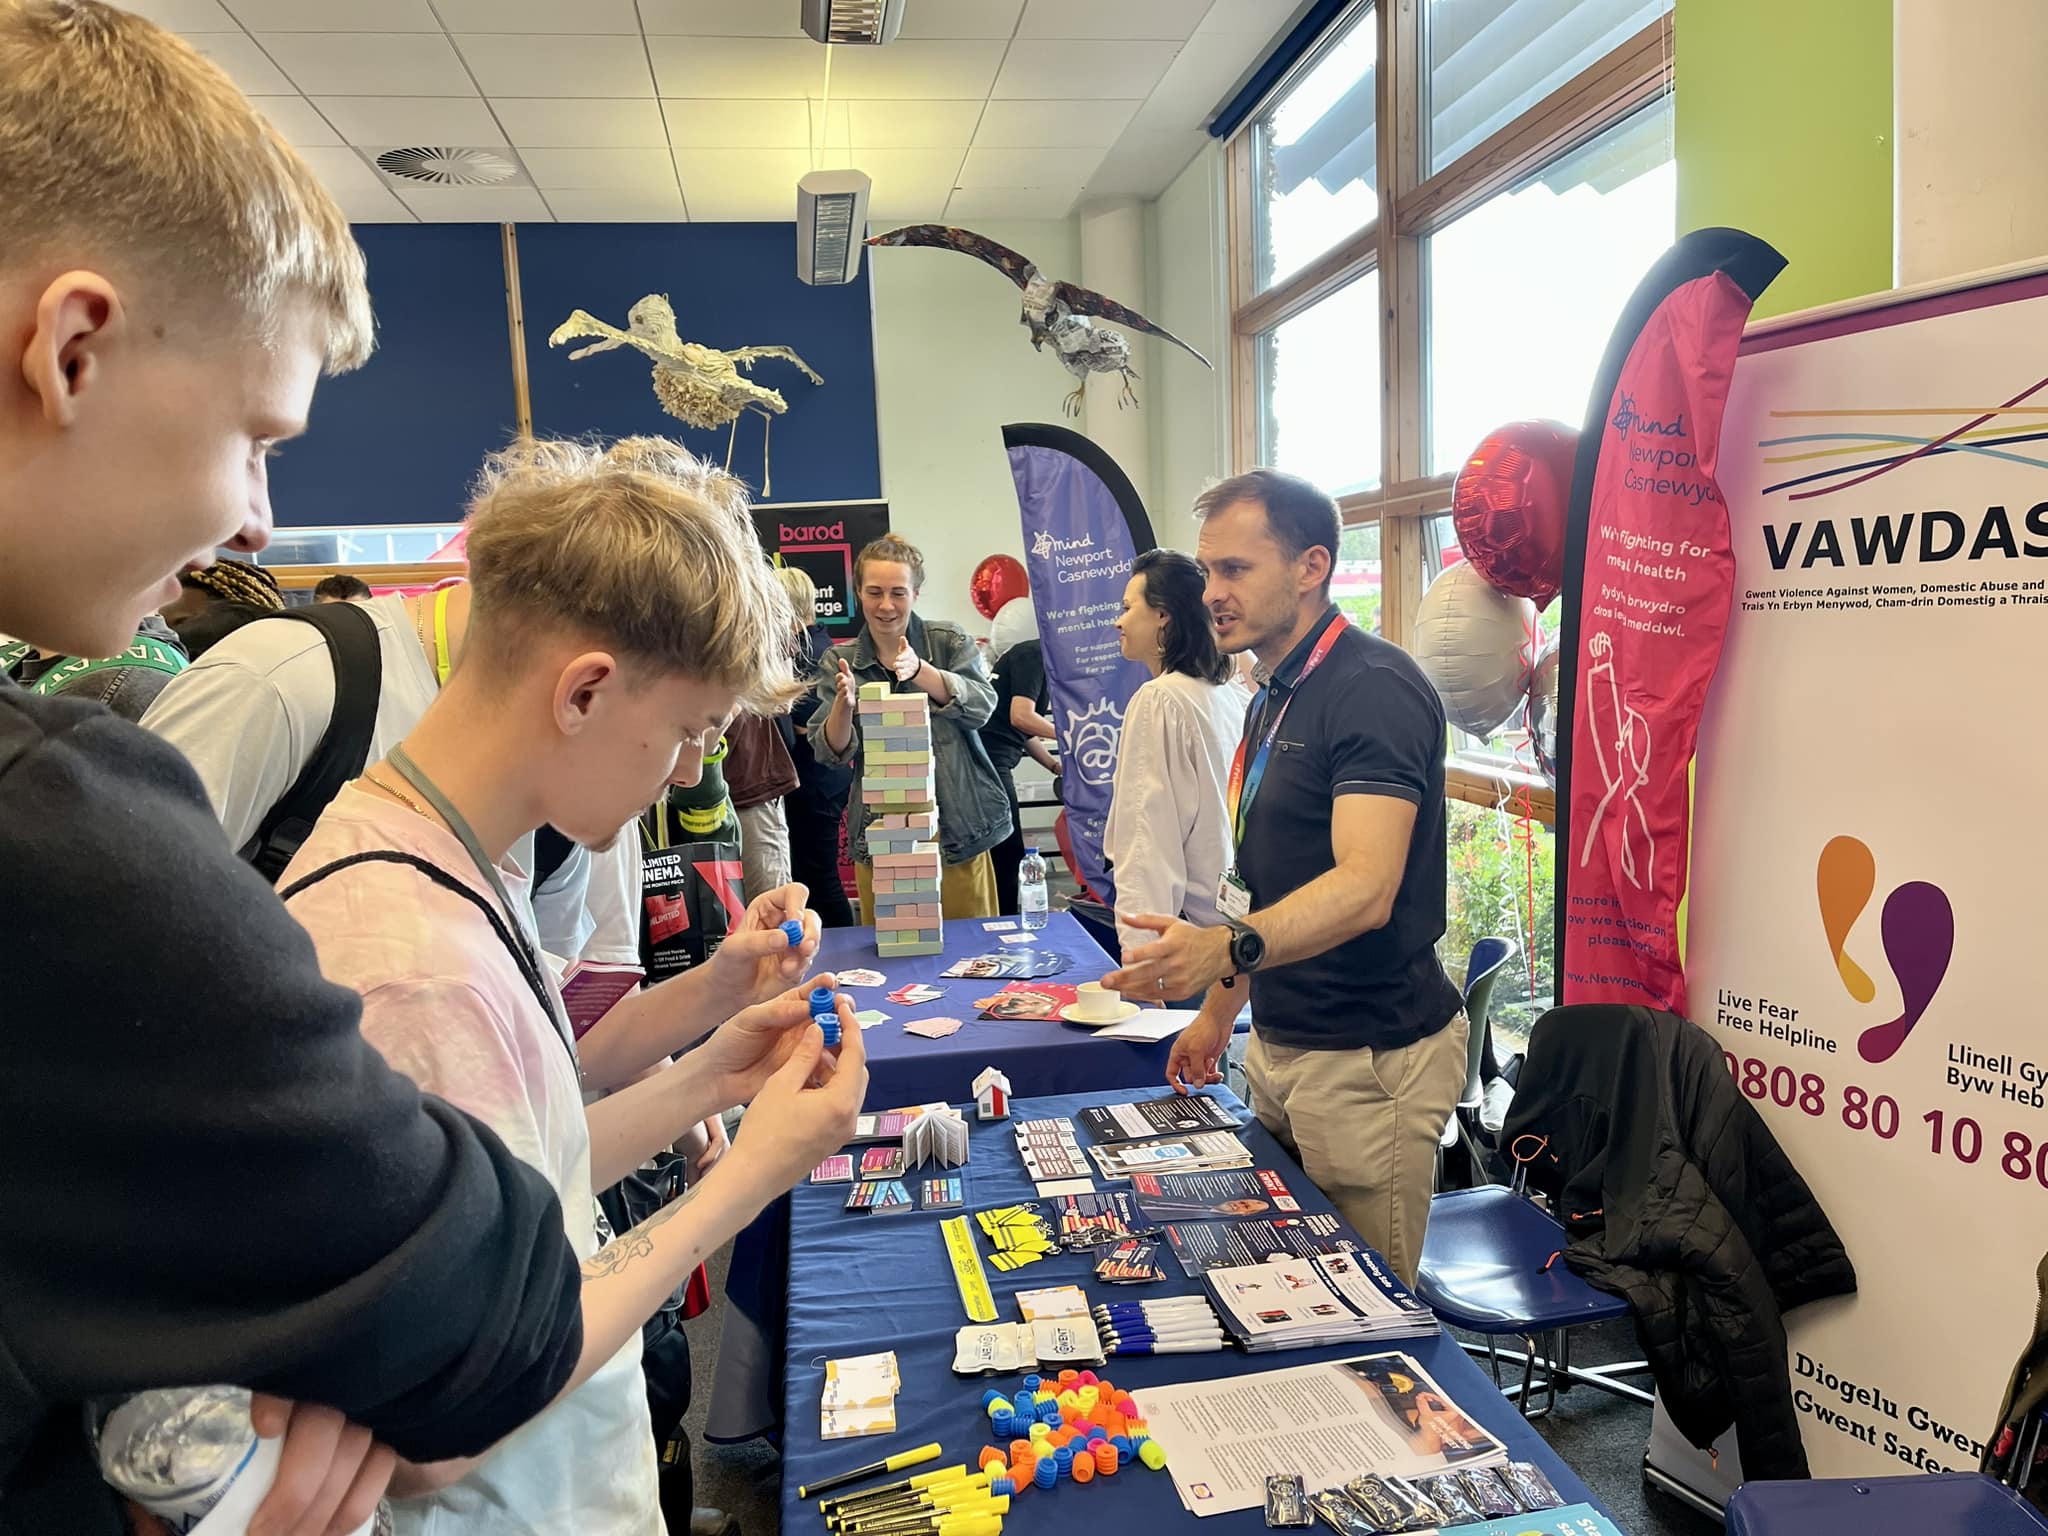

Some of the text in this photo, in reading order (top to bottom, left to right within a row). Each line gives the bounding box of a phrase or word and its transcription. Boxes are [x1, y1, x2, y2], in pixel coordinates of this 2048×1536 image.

[778, 521, 845, 542] barod
[1053, 532, 1094, 551] mind
[1620, 530, 1674, 556] fighting
[1680, 541, 1711, 558] for
[1055, 549, 1113, 568] Newport
[1057, 557, 1131, 584] Casnewydd
[1634, 560, 1686, 581] health
[815, 585, 834, 599] ent
[1745, 579, 2045, 600] Gwent Violence Against Women, Domestic Abuse and
[1046, 602, 1121, 620] We're fighting
[1628, 595, 1686, 615] brwydro
[1741, 593, 2048, 612] Trais Yn Erbyn Menywod, Cham-drin Domestig a Thrais
[1057, 619, 1096, 635] mental
[1628, 620, 1685, 637] meddwl.
[642, 865, 684, 883] INEMA
[1572, 896, 1608, 906] more
[1568, 915, 1585, 925] ow
[1591, 917, 1612, 926] we
[1718, 989, 1799, 1022] Live Fear
[1717, 1010, 1837, 1053] Free Helpline
[1948, 1043, 2012, 1076] Llinell
[1947, 1067, 2045, 1109] Byw Heb
[1841, 1085, 1900, 1140] 80
[1923, 1109, 1983, 1164] 10
[1795, 1352, 1986, 1459] Diogelu Gwen
[1794, 1390, 1877, 1446] Gwent
